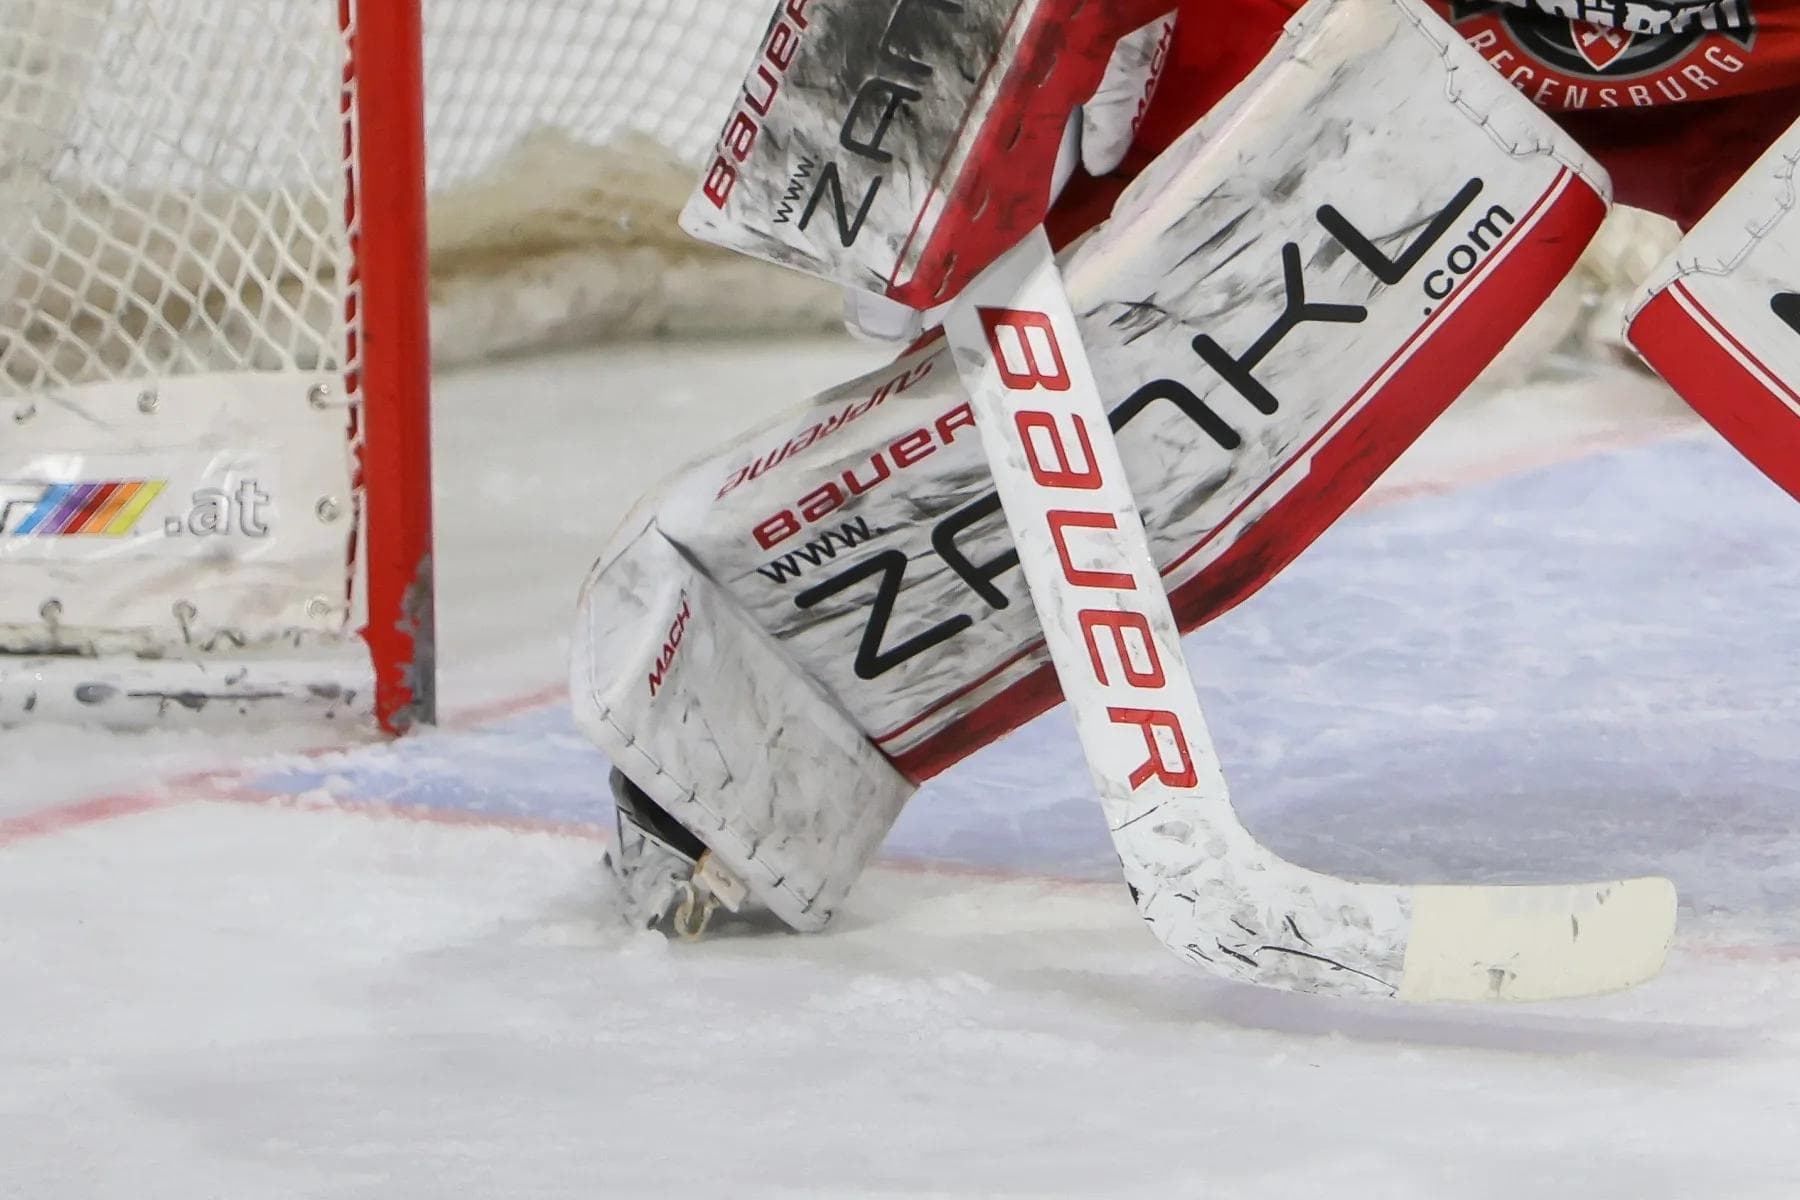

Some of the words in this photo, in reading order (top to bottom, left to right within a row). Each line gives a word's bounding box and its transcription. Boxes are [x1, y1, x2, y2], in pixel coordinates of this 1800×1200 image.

[773, 151, 818, 225] www.
[1422, 203, 1516, 317] .com
[756, 514, 887, 585] www.
[649, 599, 692, 698] MACH
